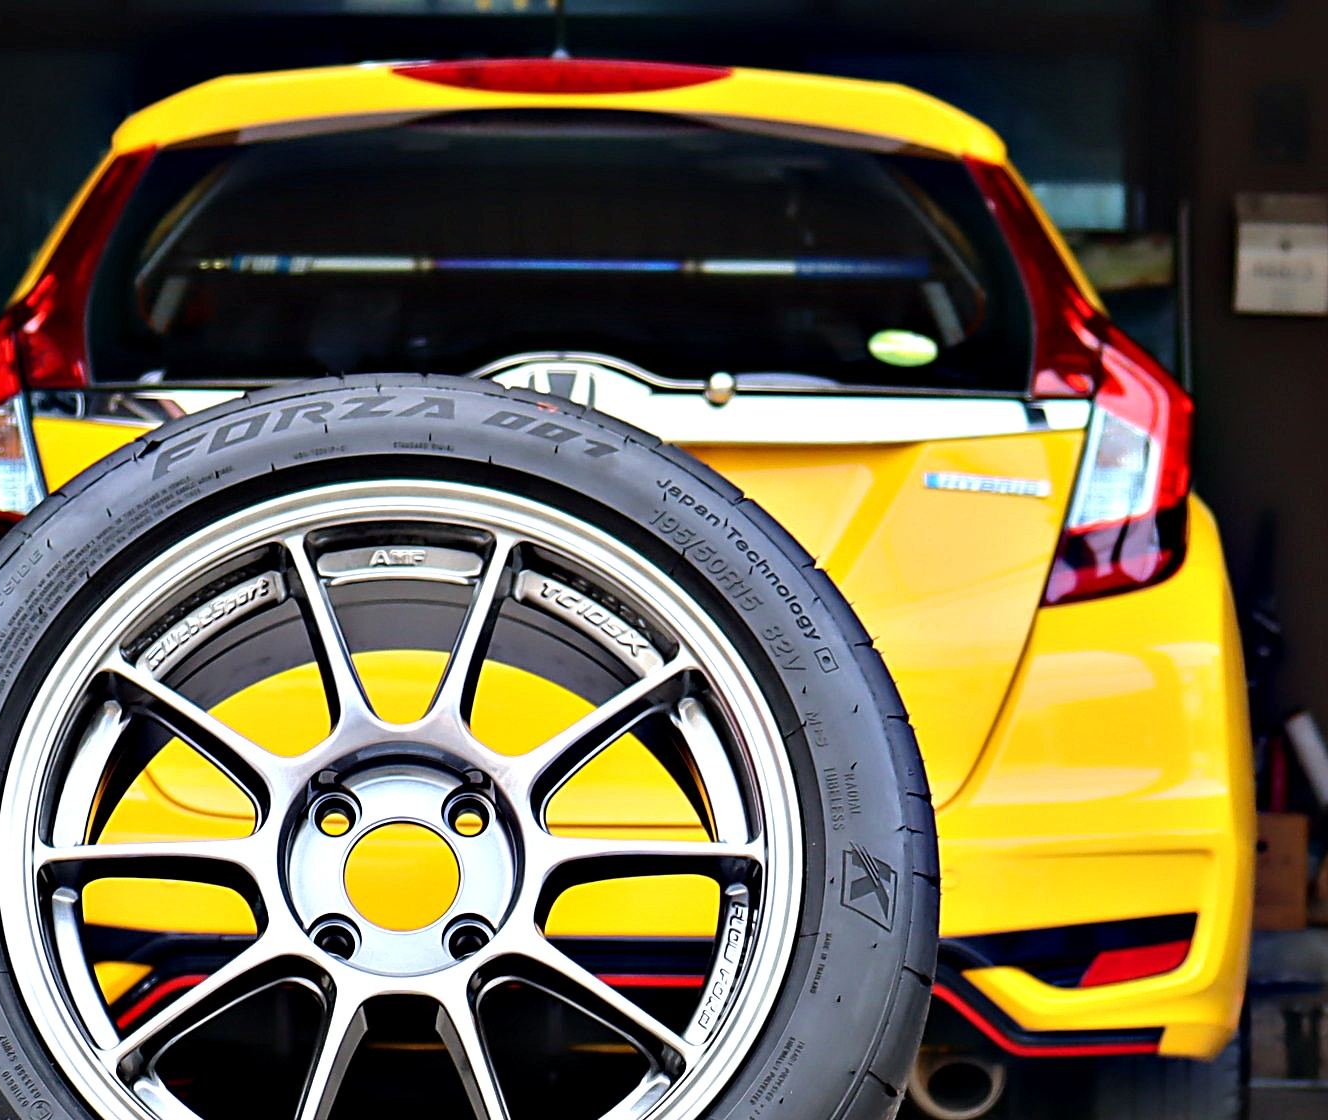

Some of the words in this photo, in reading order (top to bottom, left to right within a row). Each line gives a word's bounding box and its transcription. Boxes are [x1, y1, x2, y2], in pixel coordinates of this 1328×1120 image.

[140, 395, 456, 480] FORZA
[482, 408, 620, 464] 001
[653, 474, 724, 527] Japan
[719, 526, 828, 644] Technology
